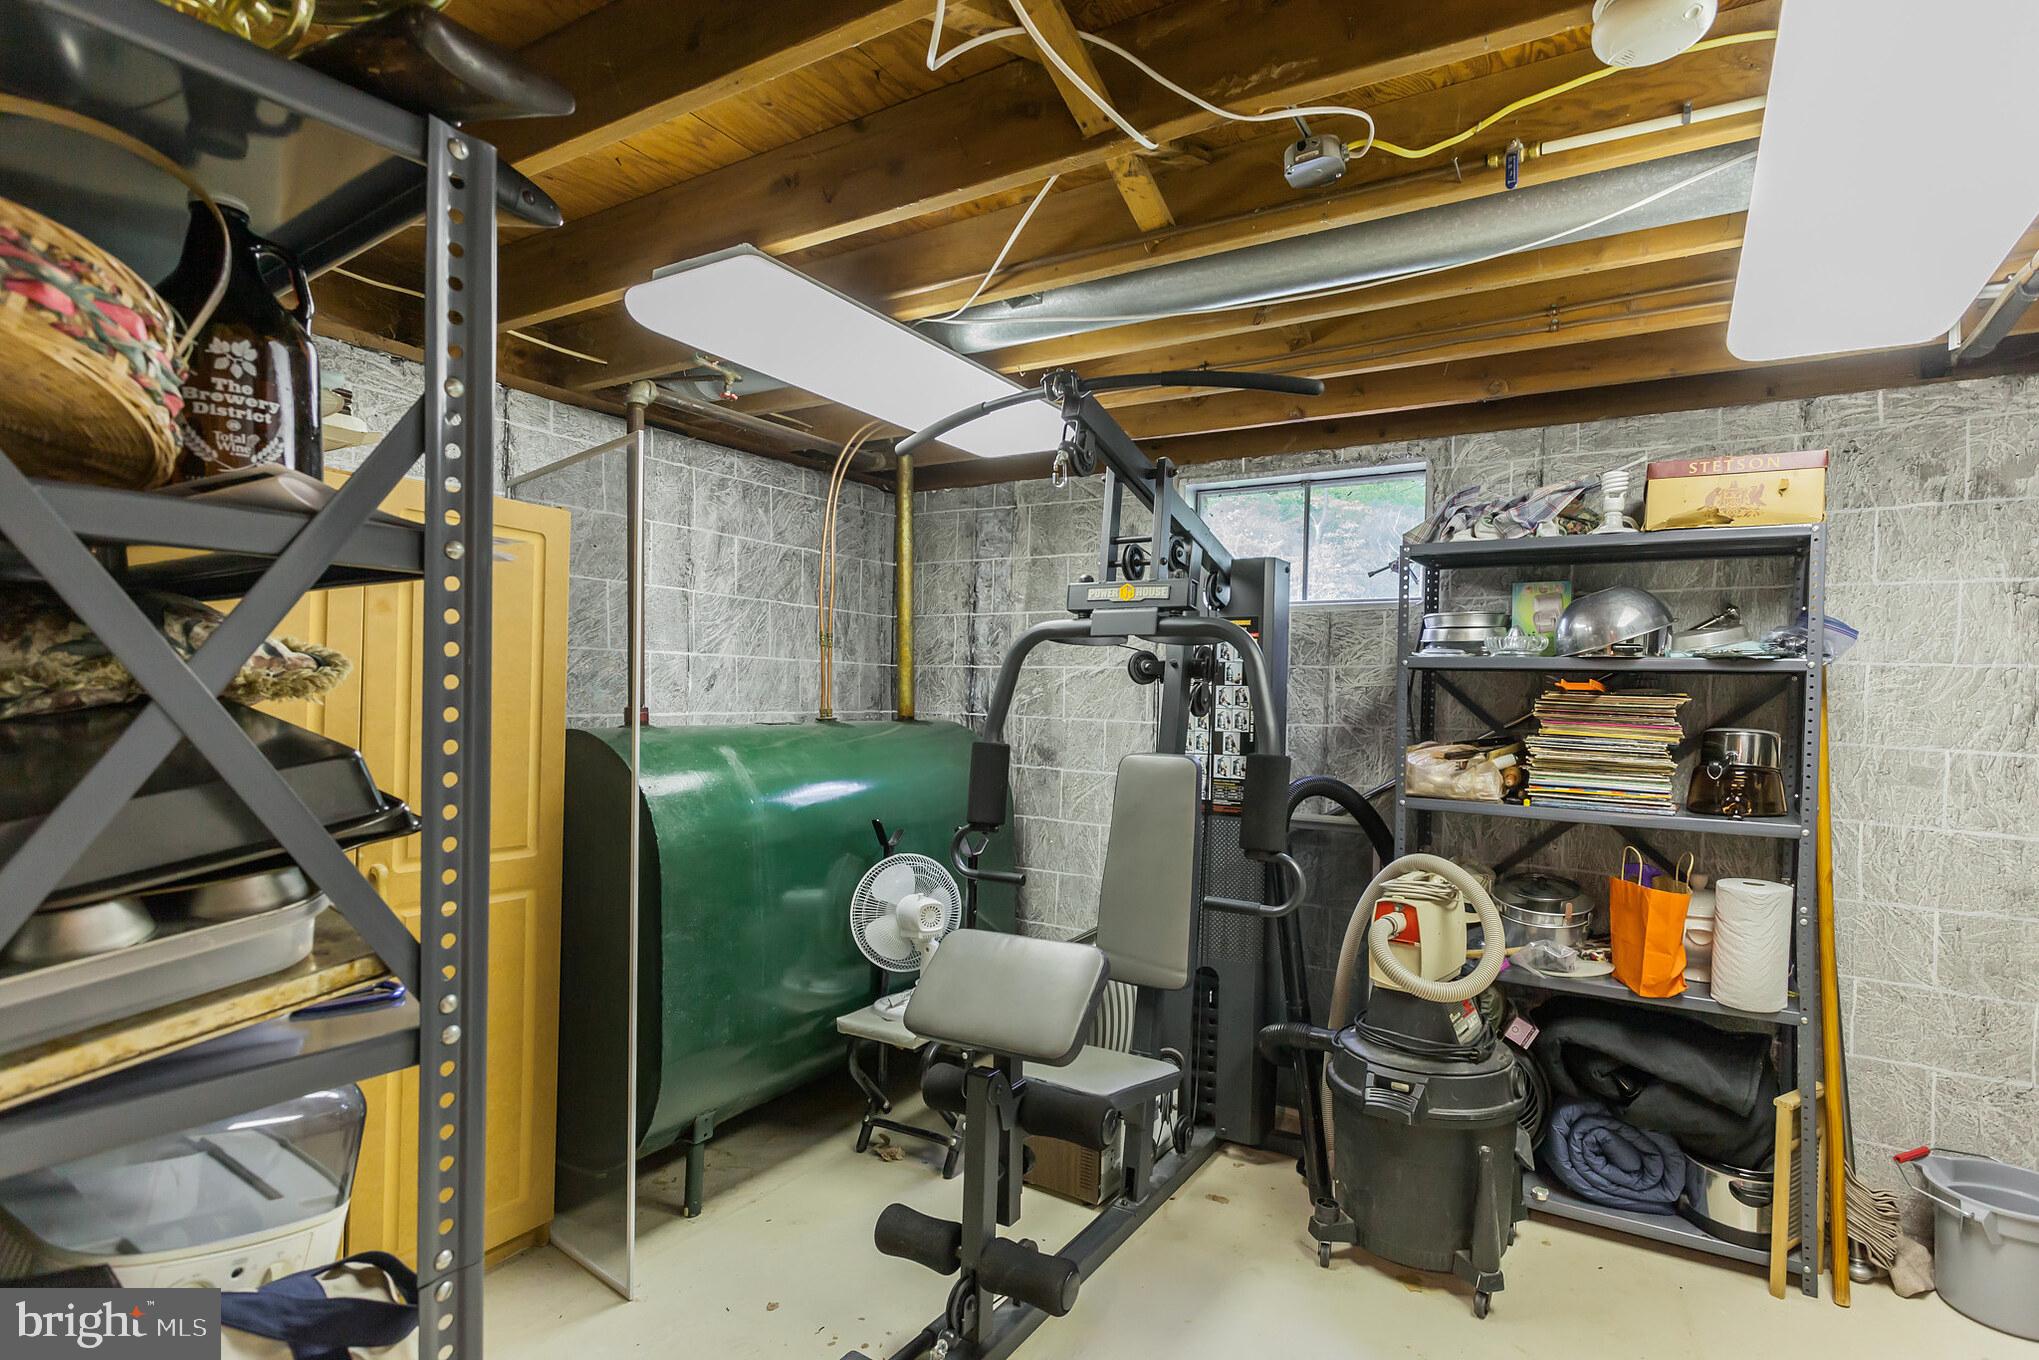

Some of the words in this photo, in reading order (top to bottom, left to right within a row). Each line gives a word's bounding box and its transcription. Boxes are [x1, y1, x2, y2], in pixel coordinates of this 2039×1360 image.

[211, 377, 253, 394] The
[181, 386, 281, 414] Brewery
[191, 402, 272, 424] District
[213, 430, 246, 444] Total
[216, 440, 252, 453] Wine
[1689, 456, 1780, 474] STETSON
[1088, 588, 1118, 598] POWER
[1136, 586, 1169, 597] HOUSE
